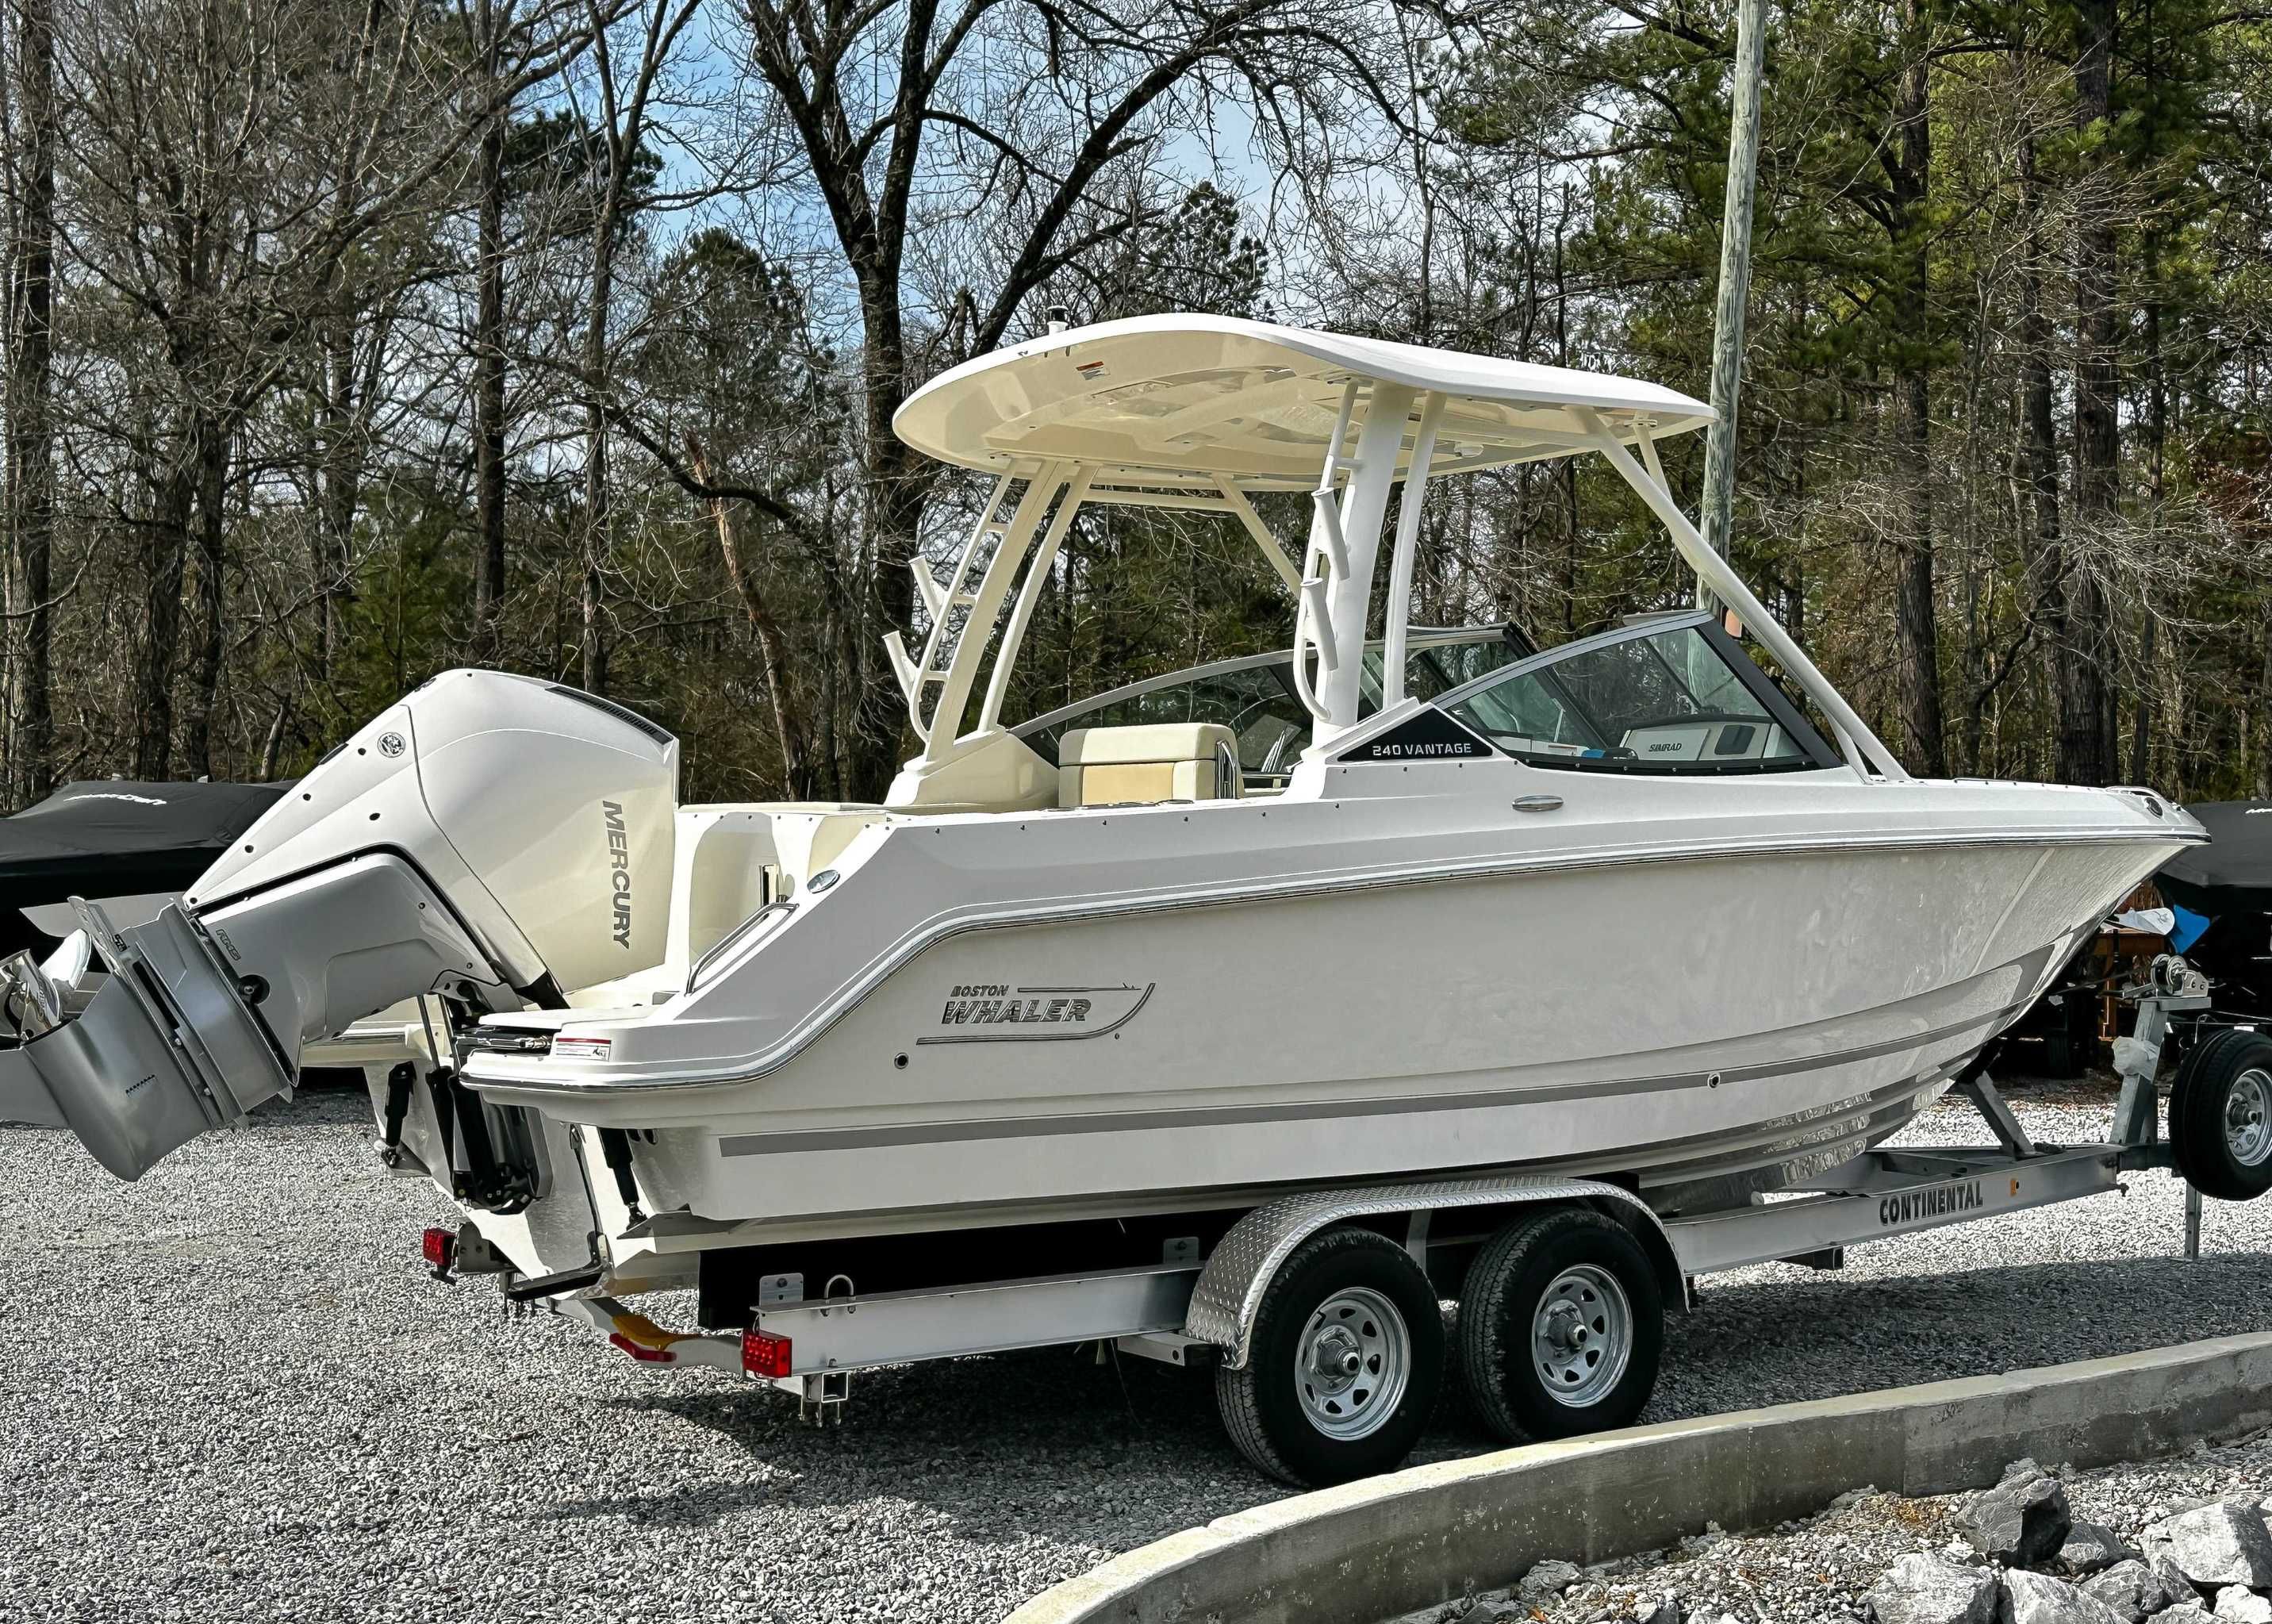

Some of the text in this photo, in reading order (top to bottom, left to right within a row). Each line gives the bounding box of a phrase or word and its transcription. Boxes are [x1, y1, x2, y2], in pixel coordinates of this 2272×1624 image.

[1372, 743, 1472, 756] 240 VANTAGE
[1648, 743, 1683, 753] SIMRAD
[602, 800, 631, 950] MERCURY
[950, 985, 1009, 997] BOSTON
[942, 998, 1092, 1024] WHALER
[1879, 1180, 1983, 1226] CONTINENTAL
